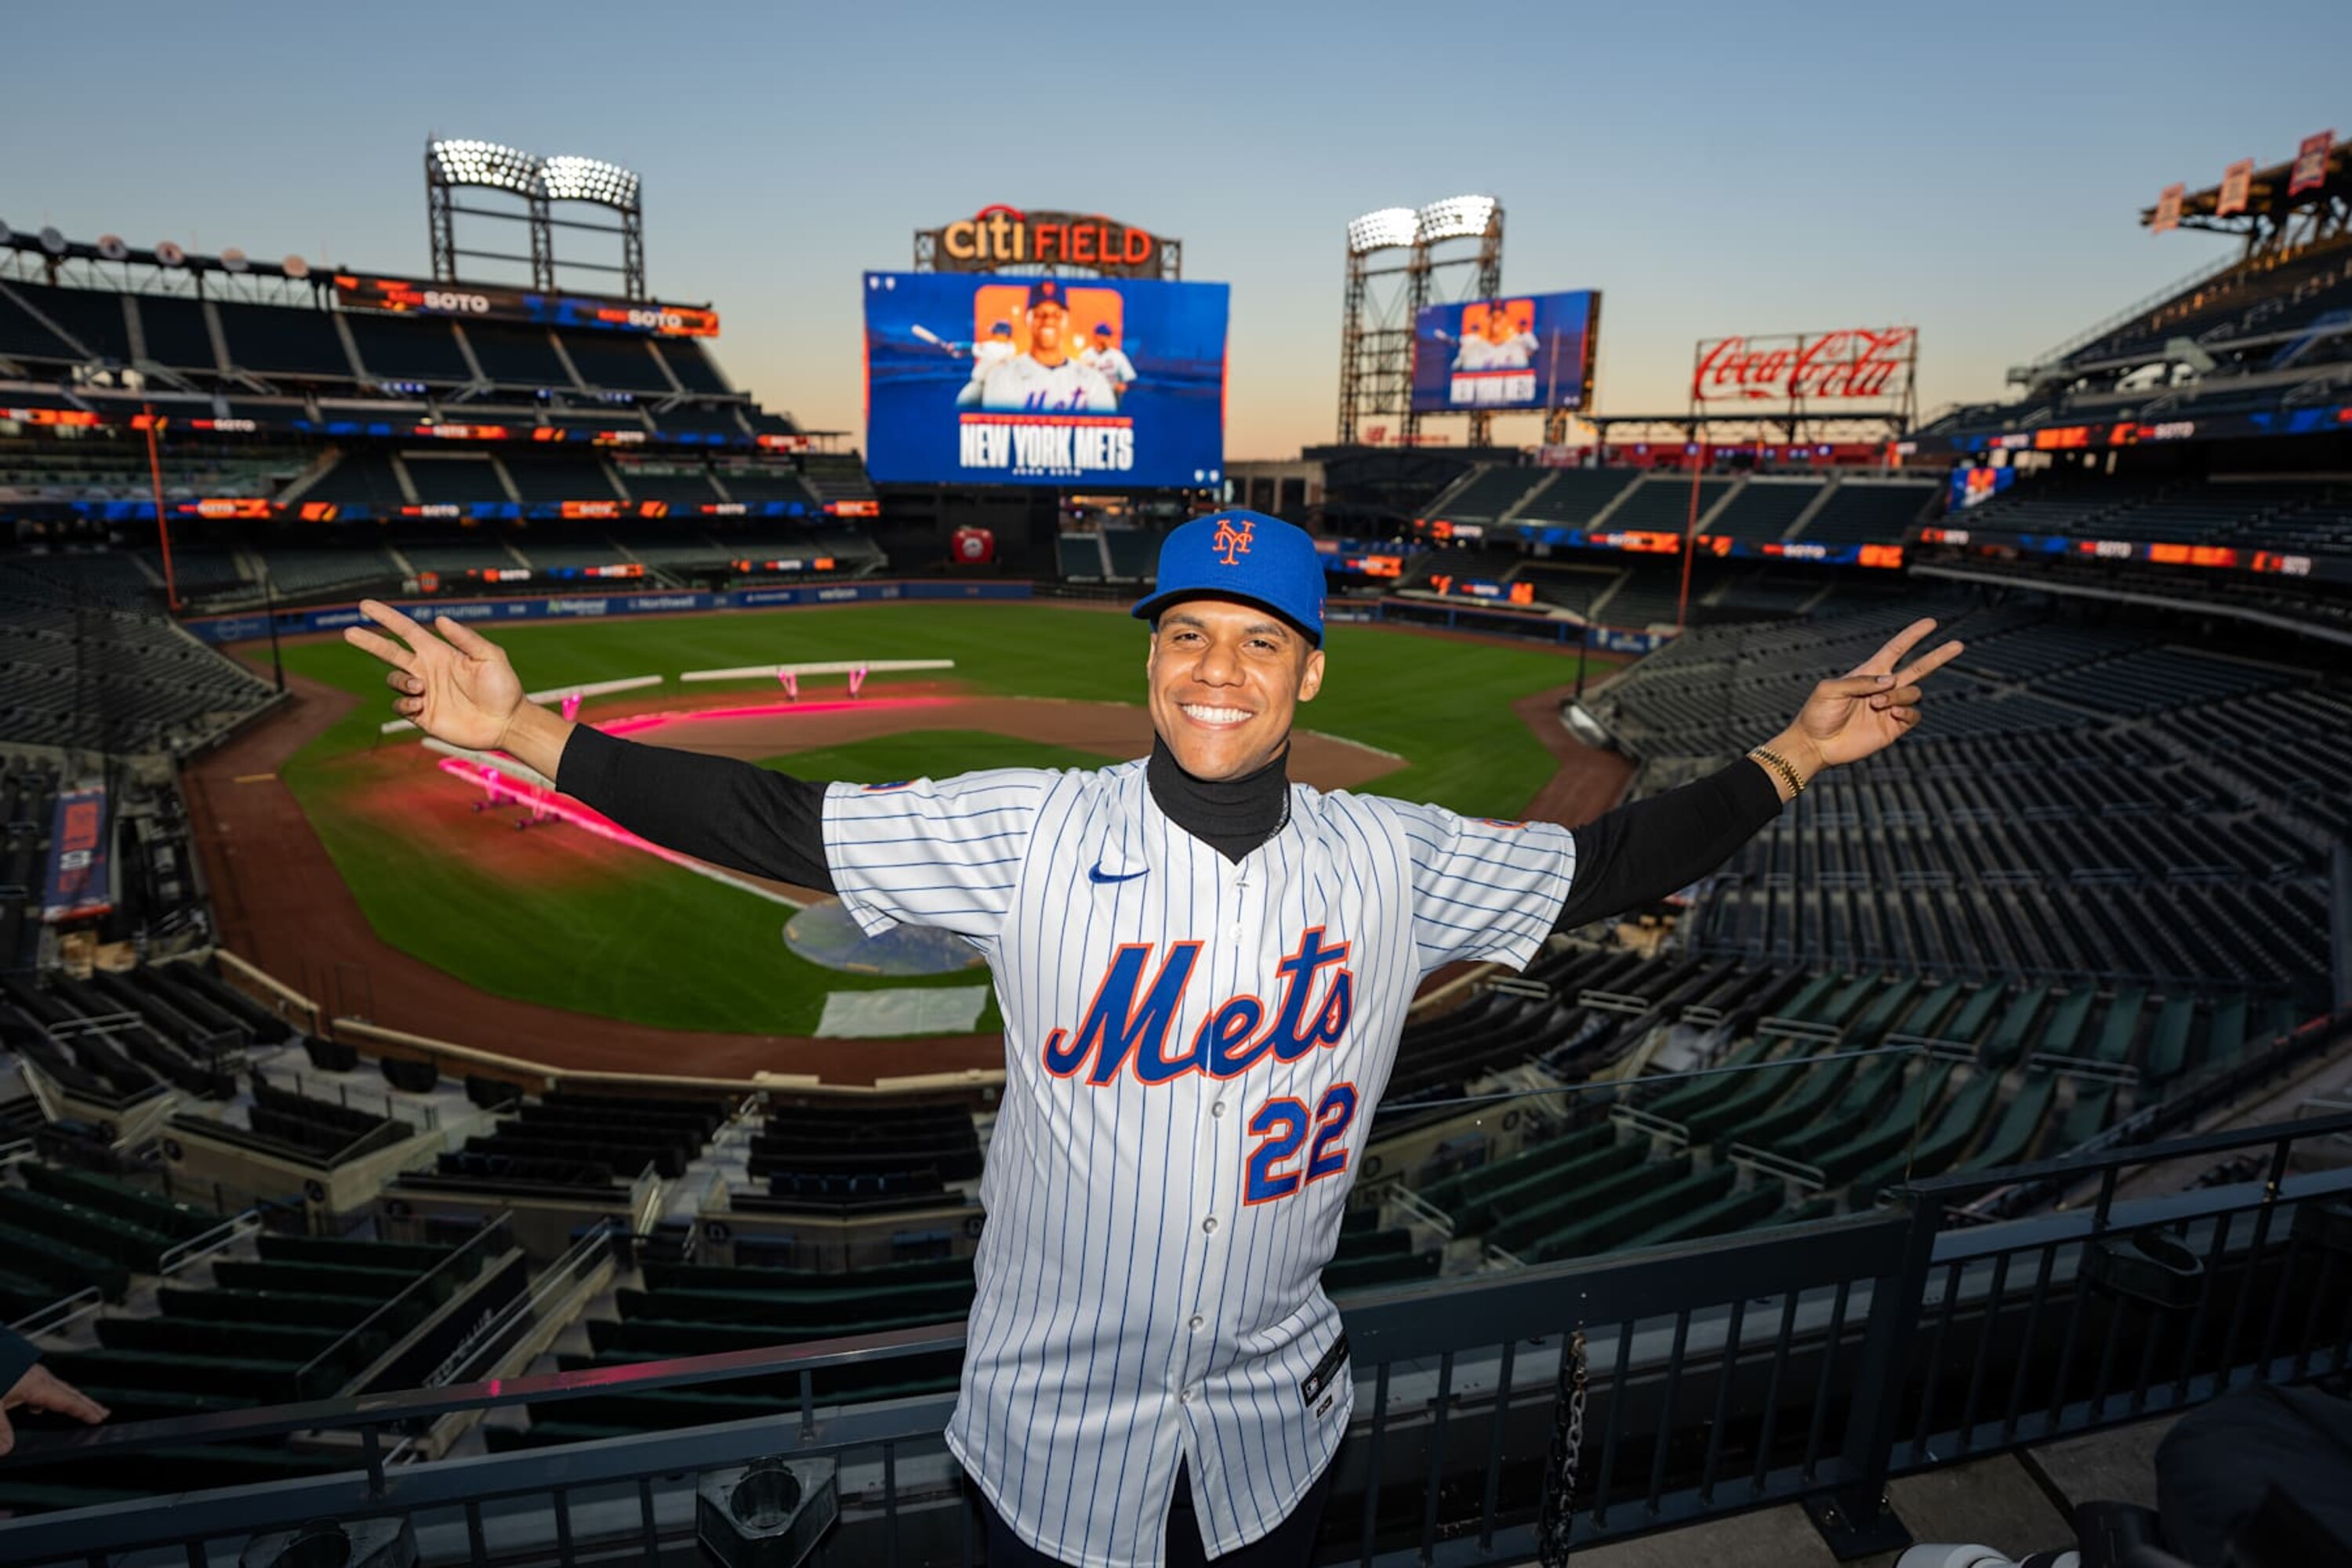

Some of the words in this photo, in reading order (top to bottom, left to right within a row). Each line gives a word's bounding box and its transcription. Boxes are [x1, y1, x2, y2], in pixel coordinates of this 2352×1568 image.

[1034, 224, 1152, 264] FIELD
[423, 291, 490, 314] SOTO
[628, 309, 683, 328] SOTO
[960, 423, 1011, 468] NEW
[1012, 424, 1073, 469] YORK
[1073, 426, 1134, 471] METS
[1043, 924, 1353, 1087] Mets
[1243, 1081, 1359, 1207] 22
